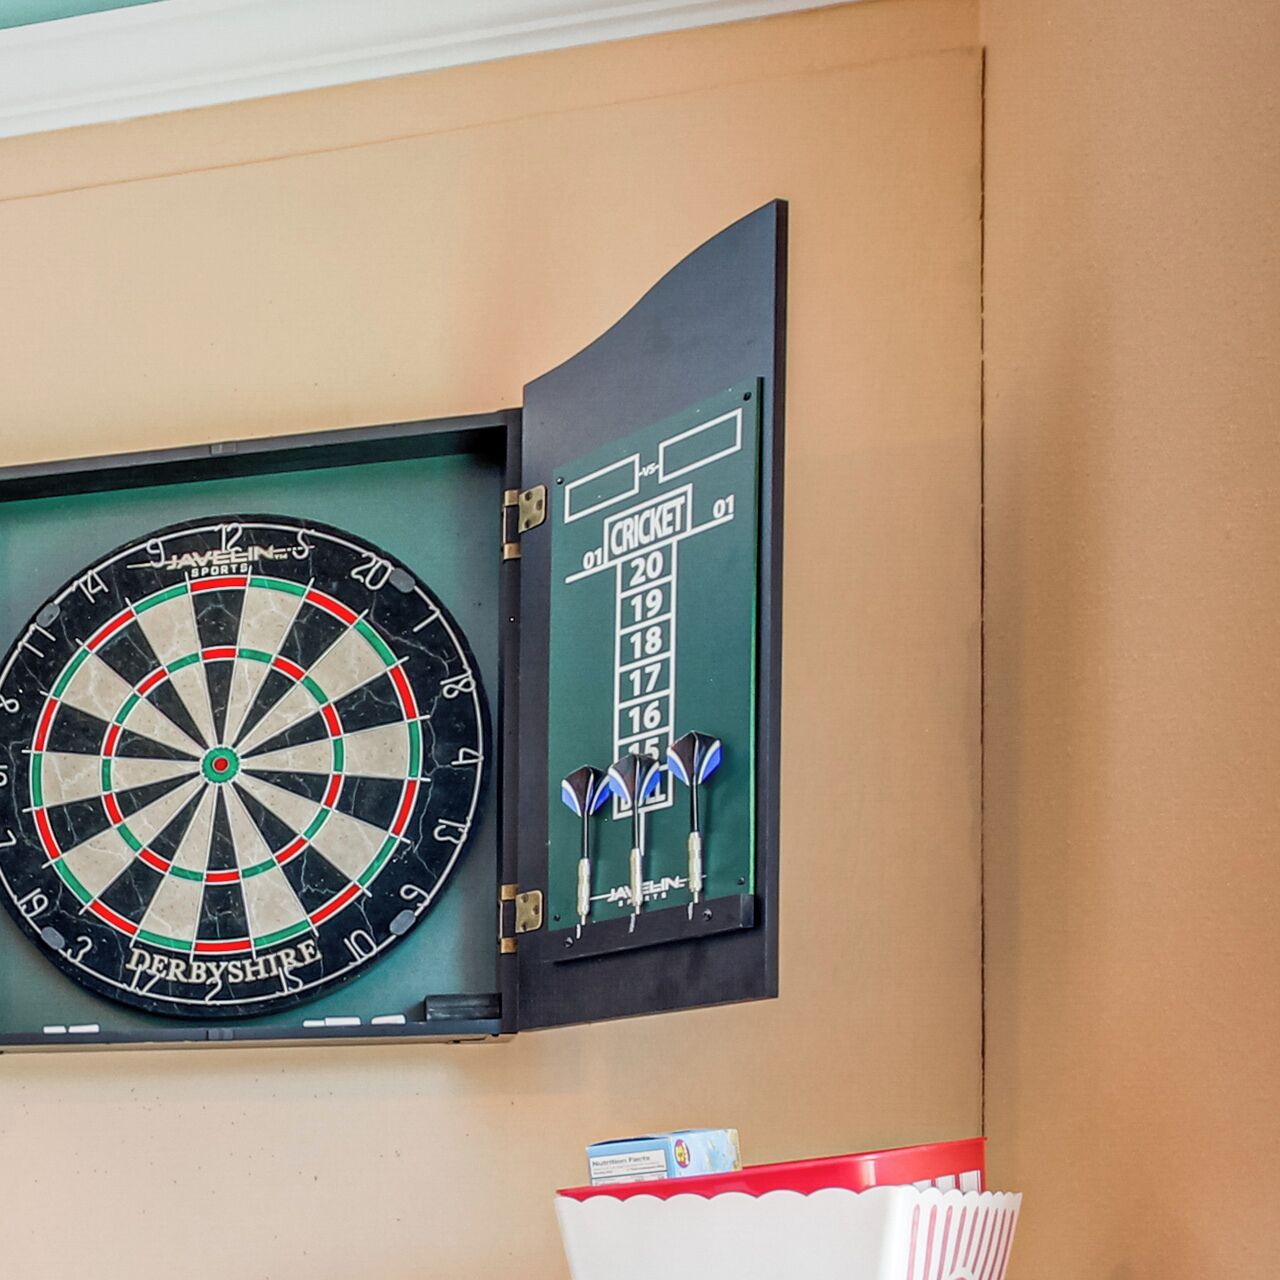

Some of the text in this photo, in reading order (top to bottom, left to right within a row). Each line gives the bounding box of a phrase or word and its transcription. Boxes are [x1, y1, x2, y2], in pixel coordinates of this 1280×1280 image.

[712, 494, 734, 518] 01
[215, 523, 243, 552] 12
[610, 495, 685, 556] CRICKET
[146, 538, 165, 568] 9
[166, 544, 275, 570] JAVELIN
[292, 529, 310, 560] 5
[583, 547, 602, 570] 01
[190, 563, 248, 578] SPORTS
[351, 552, 393, 591] 20
[630, 550, 664, 587] 20
[73, 571, 109, 604] 14
[631, 588, 663, 622] 19
[17, 622, 56, 658] 11
[630, 626, 662, 659] 18
[440, 667, 476, 700] 18
[629, 662, 662, 697] 17
[628, 700, 662, 734] 16
[452, 747, 484, 767] 4
[434, 817, 471, 844] 13
[13, 888, 49, 918] 19
[67, 935, 92, 963] 3
[125, 939, 323, 984] DERBYSHIRE
[344, 928, 378, 965] 10
[122, 964, 162, 996] 17
[276, 966, 304, 996] 15
